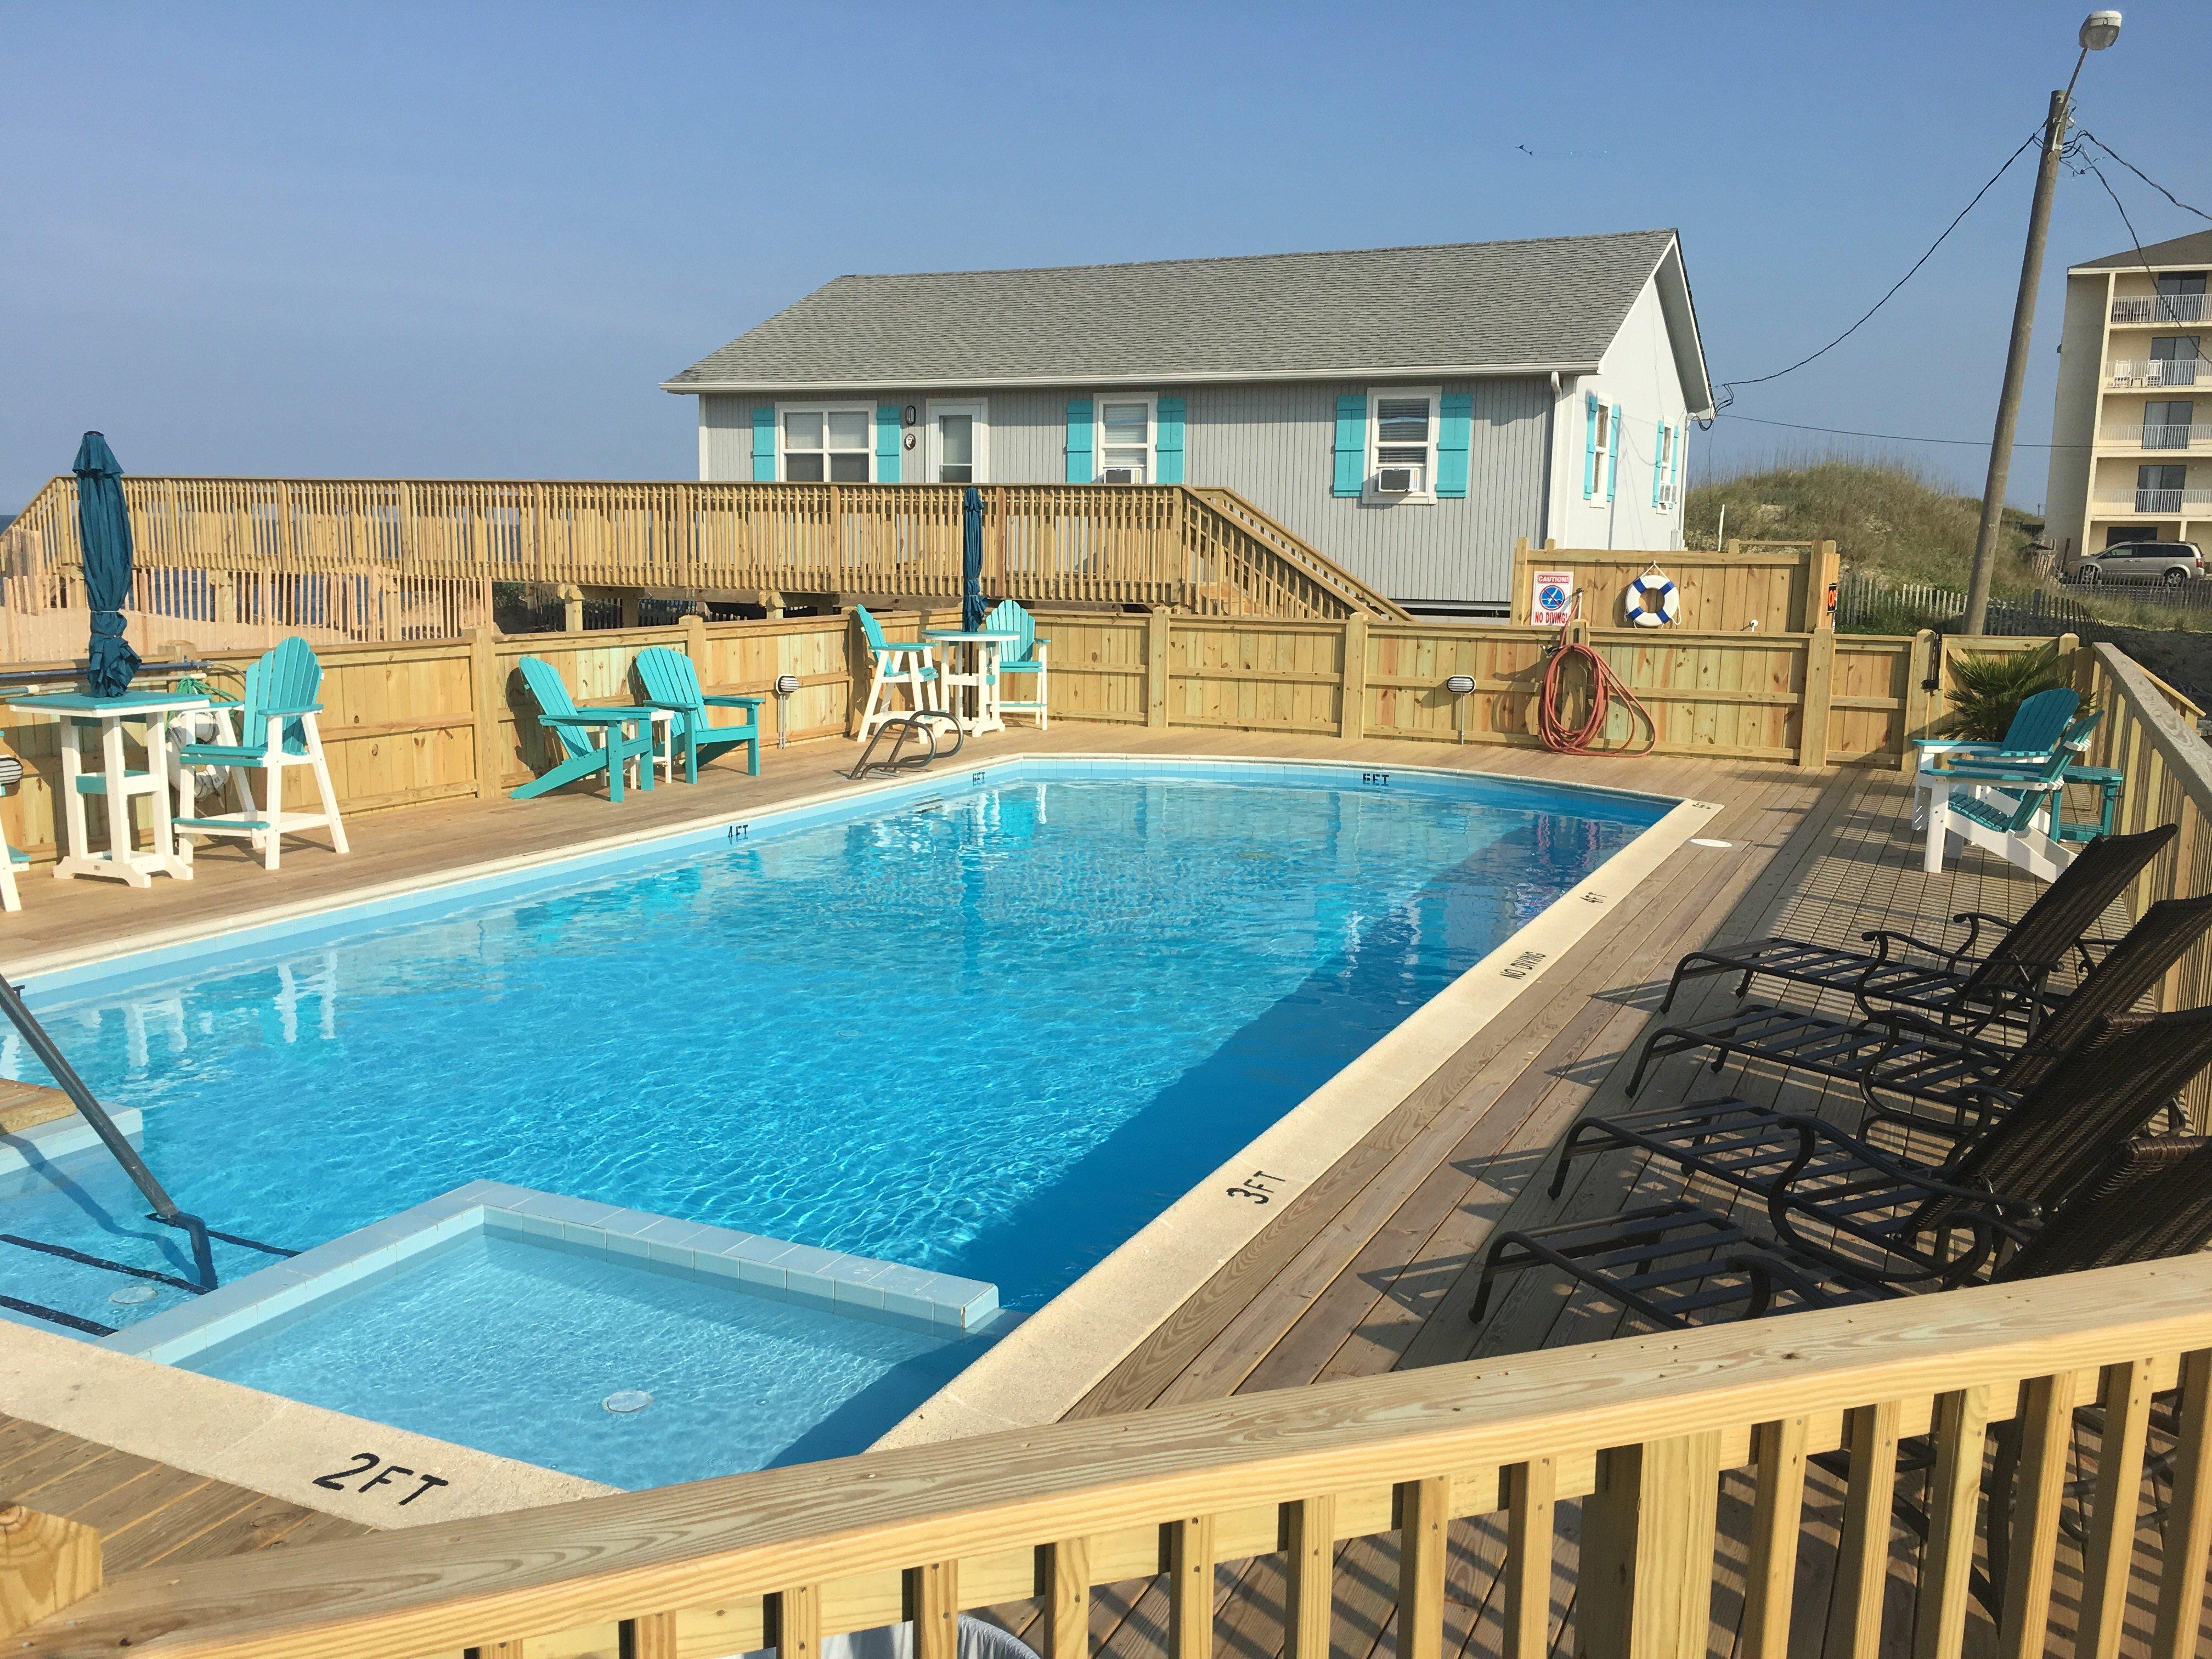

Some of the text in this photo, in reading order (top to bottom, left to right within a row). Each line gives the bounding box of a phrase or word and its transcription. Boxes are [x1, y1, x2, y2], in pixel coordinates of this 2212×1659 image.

[1535, 612, 1568, 624] NO DIVING!
[1580, 892, 1607, 903] 4FT
[1499, 951, 1546, 979] NO DIVING
[1226, 1170, 1286, 1204] 3FT
[312, 1452, 449, 1505] 2FT
